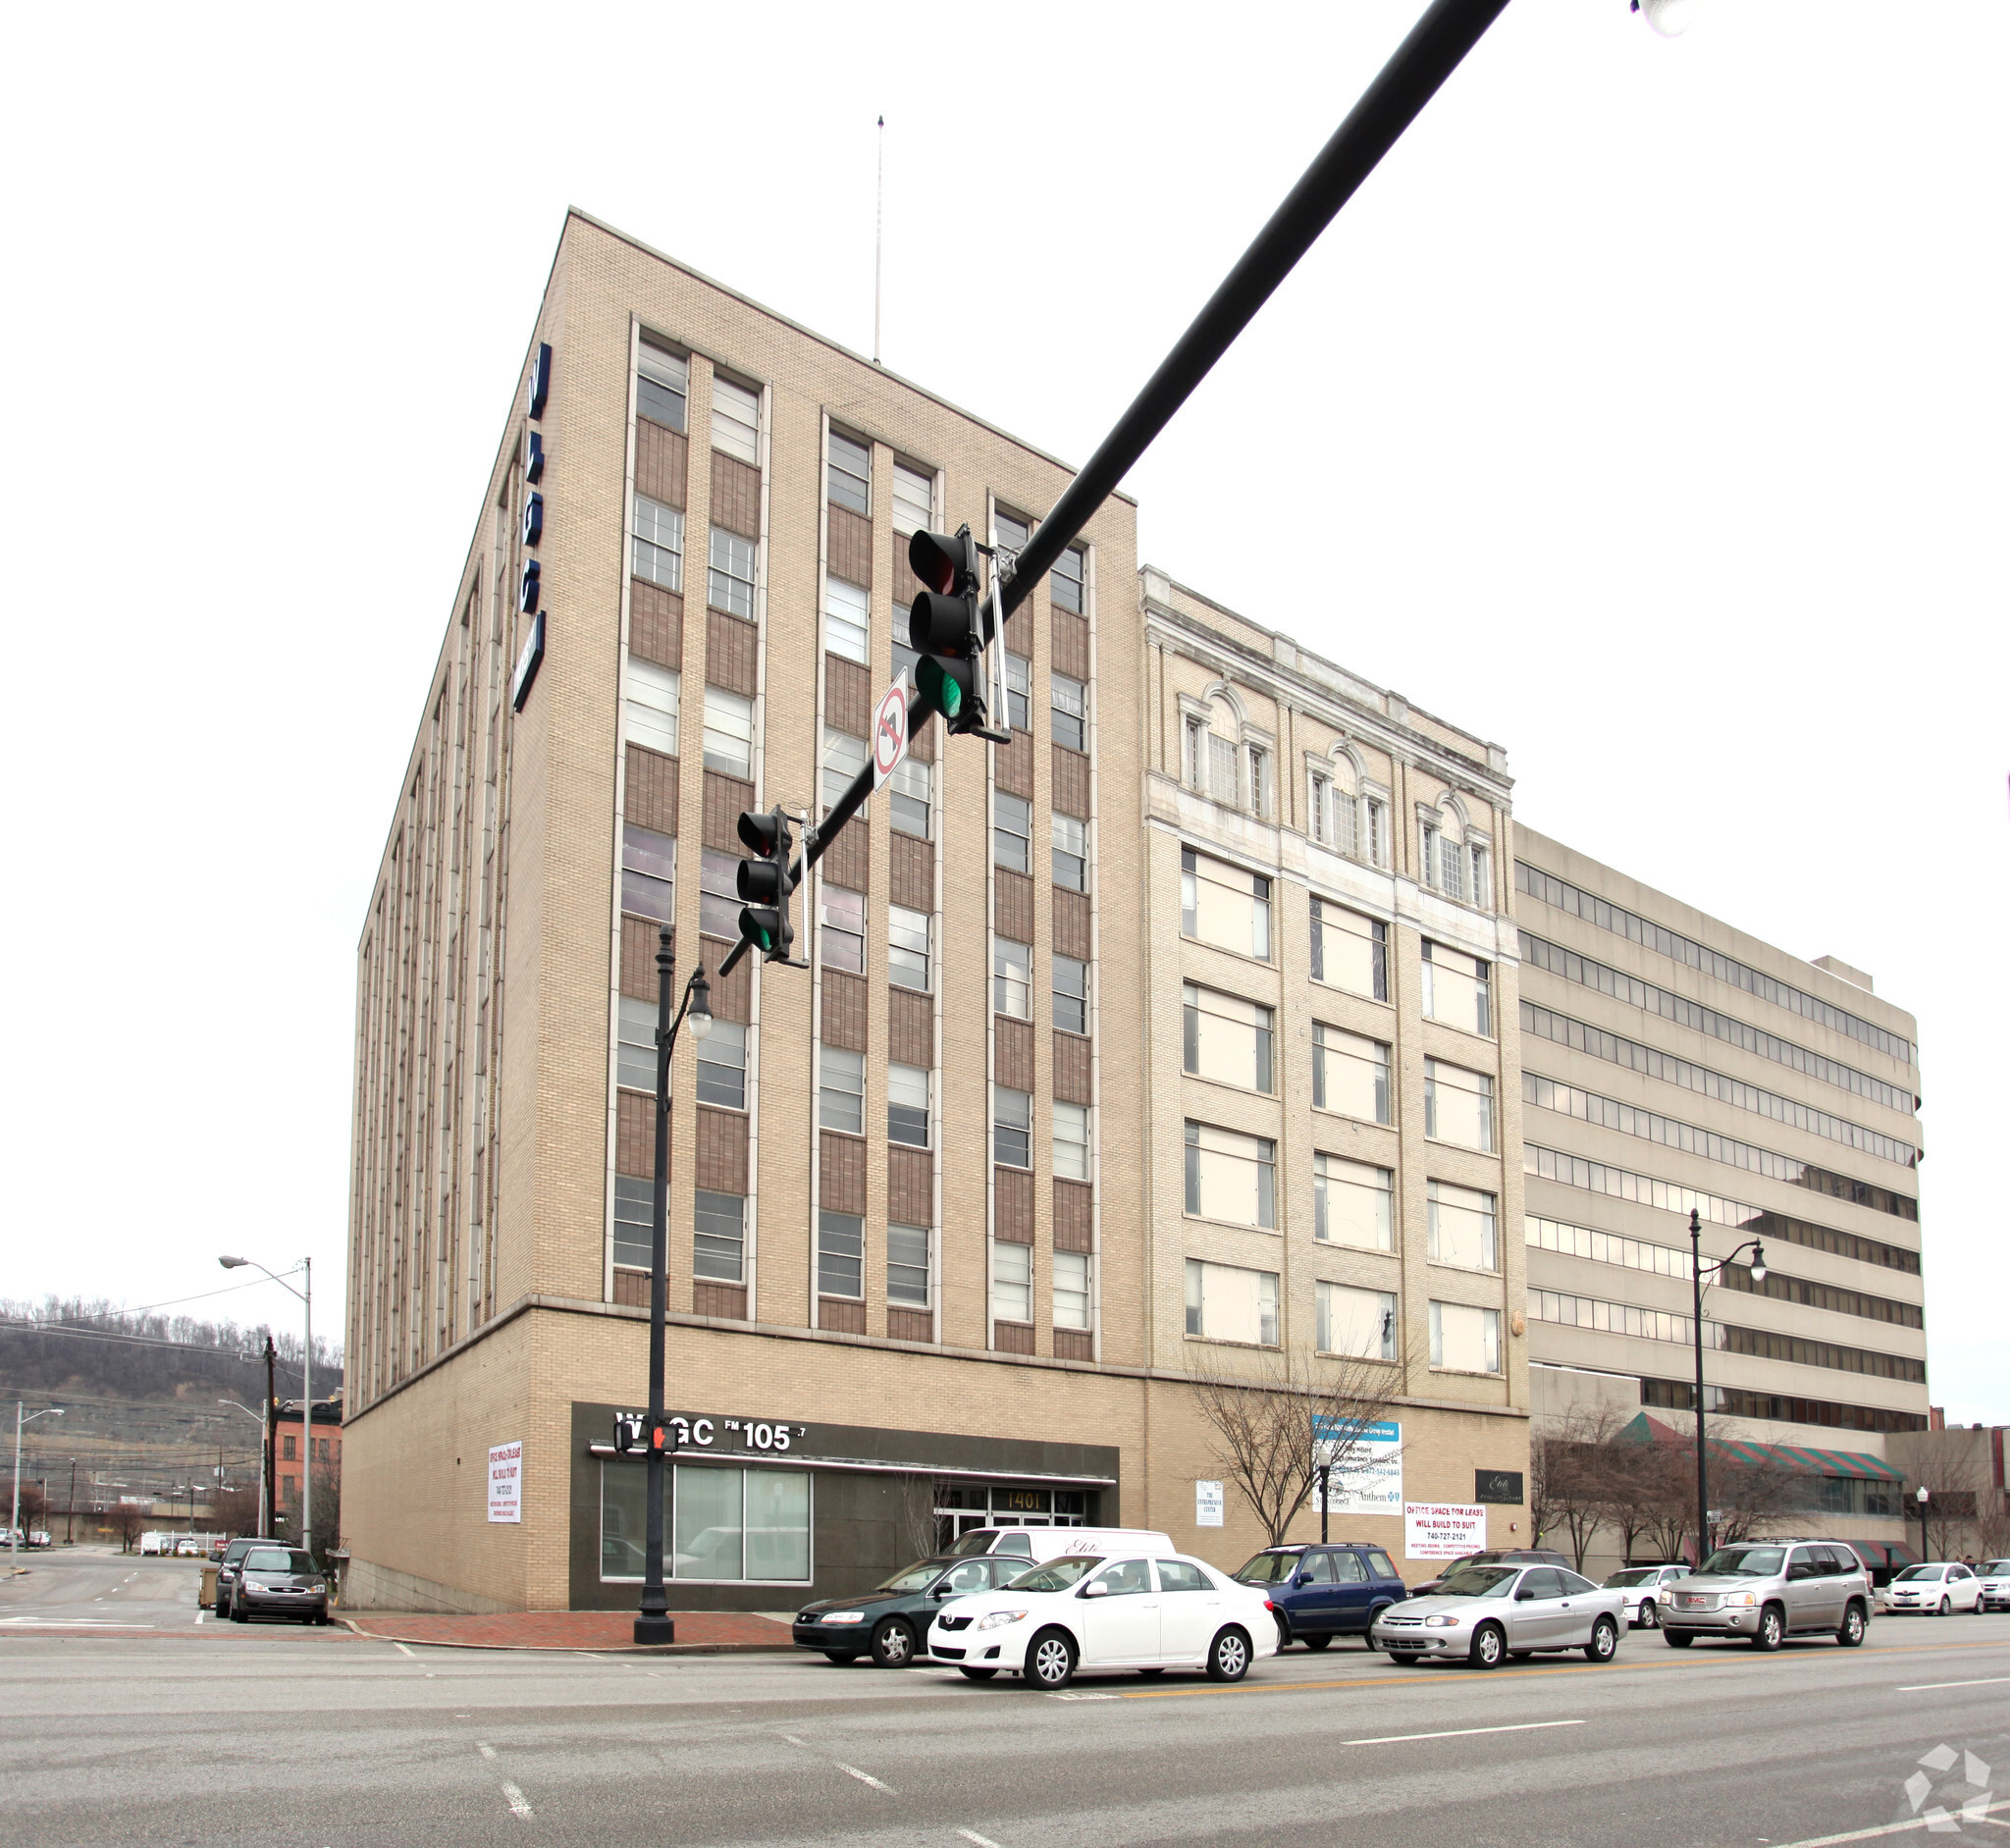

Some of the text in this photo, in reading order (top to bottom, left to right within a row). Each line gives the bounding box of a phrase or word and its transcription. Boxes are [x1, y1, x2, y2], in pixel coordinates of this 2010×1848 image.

[615, 1412, 714, 1446] WGC
[724, 1420, 740, 1431] FM
[1009, 1492, 1039, 1509] 1401
[1358, 1490, 1387, 1503] Anthem
[1406, 1505, 1430, 1514] OFFICE
[1452, 1520, 1460, 1529] TO
[1427, 1532, 1466, 1541] 740-727-2121
[1065, 1538, 1098, 1555] Elite
